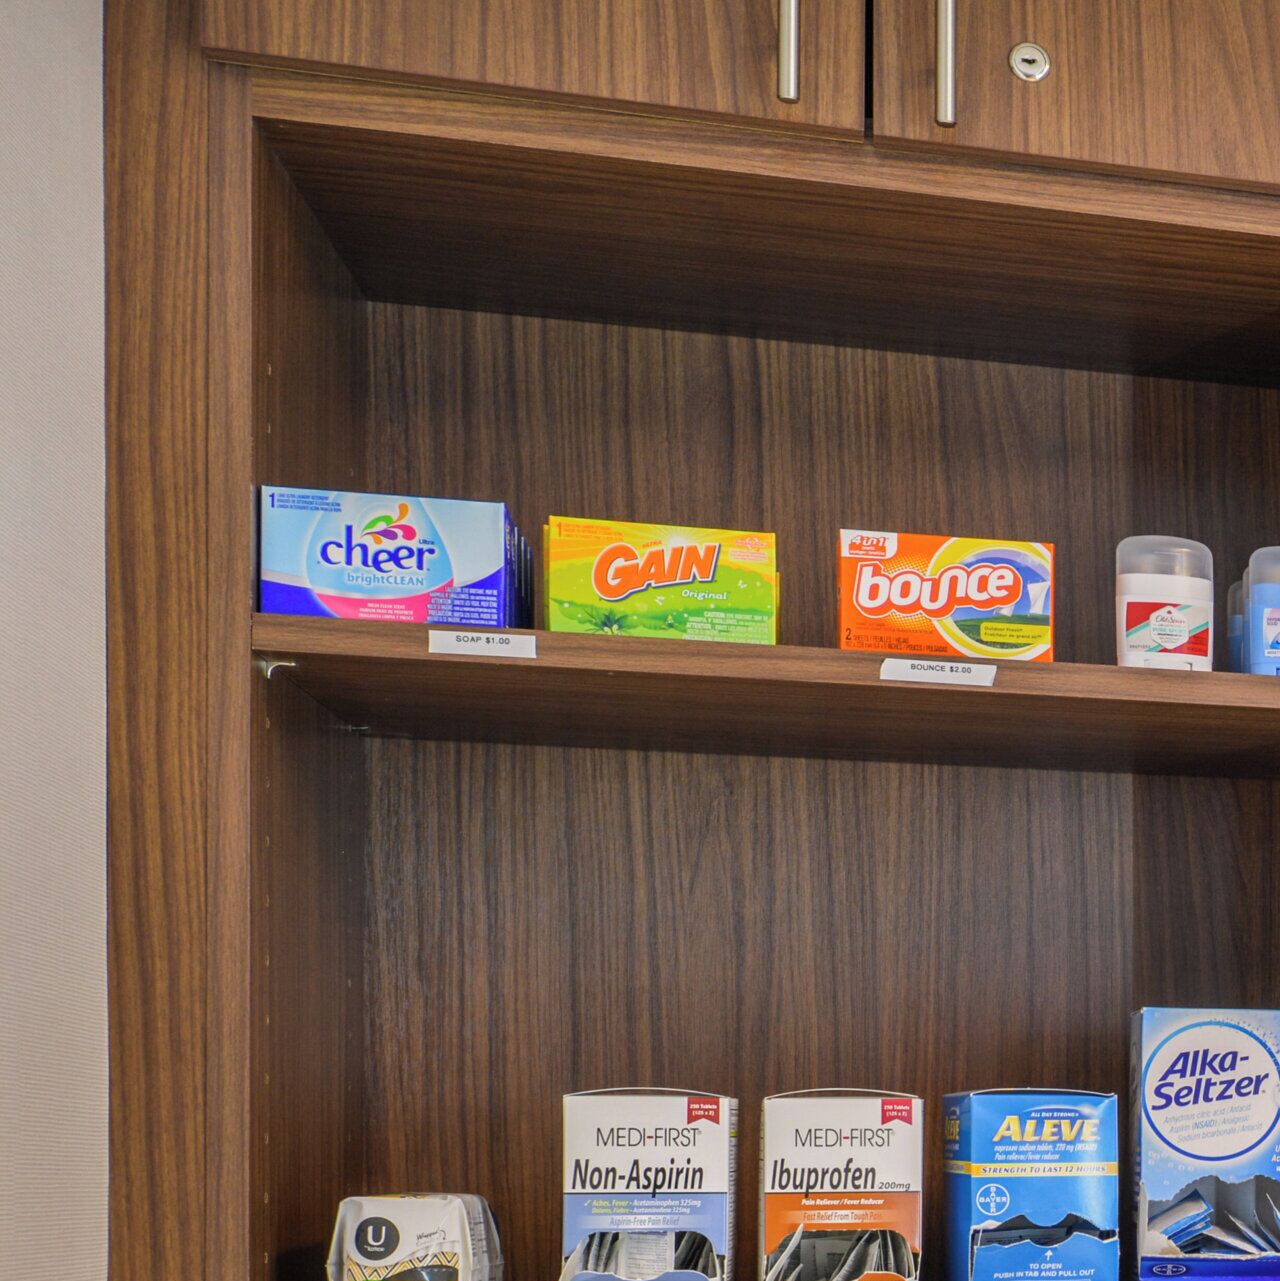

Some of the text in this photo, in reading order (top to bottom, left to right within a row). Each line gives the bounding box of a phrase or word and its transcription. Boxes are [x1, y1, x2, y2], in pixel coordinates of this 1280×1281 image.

[320, 525, 435, 573] cheer
[347, 572, 424, 587] brightCLEAN
[593, 543, 716, 600] GAIN
[682, 589, 727, 600] Original
[857, 566, 1014, 610] bounce
[455, 635, 511, 645] SOAP $1.00
[910, 663, 946, 672] BOUNCE
[1158, 1049, 1249, 1081] Alka-
[1151, 1073, 1269, 1110] Seltzer
[597, 1128, 699, 1146] MEDI-FIRST
[795, 1129, 893, 1147] MEDI-FIRST
[992, 1115, 1100, 1142] ALEVE
[572, 1158, 704, 1198] Non-Aspirin
[771, 1158, 910, 1198] Ibuprofen 200mg
